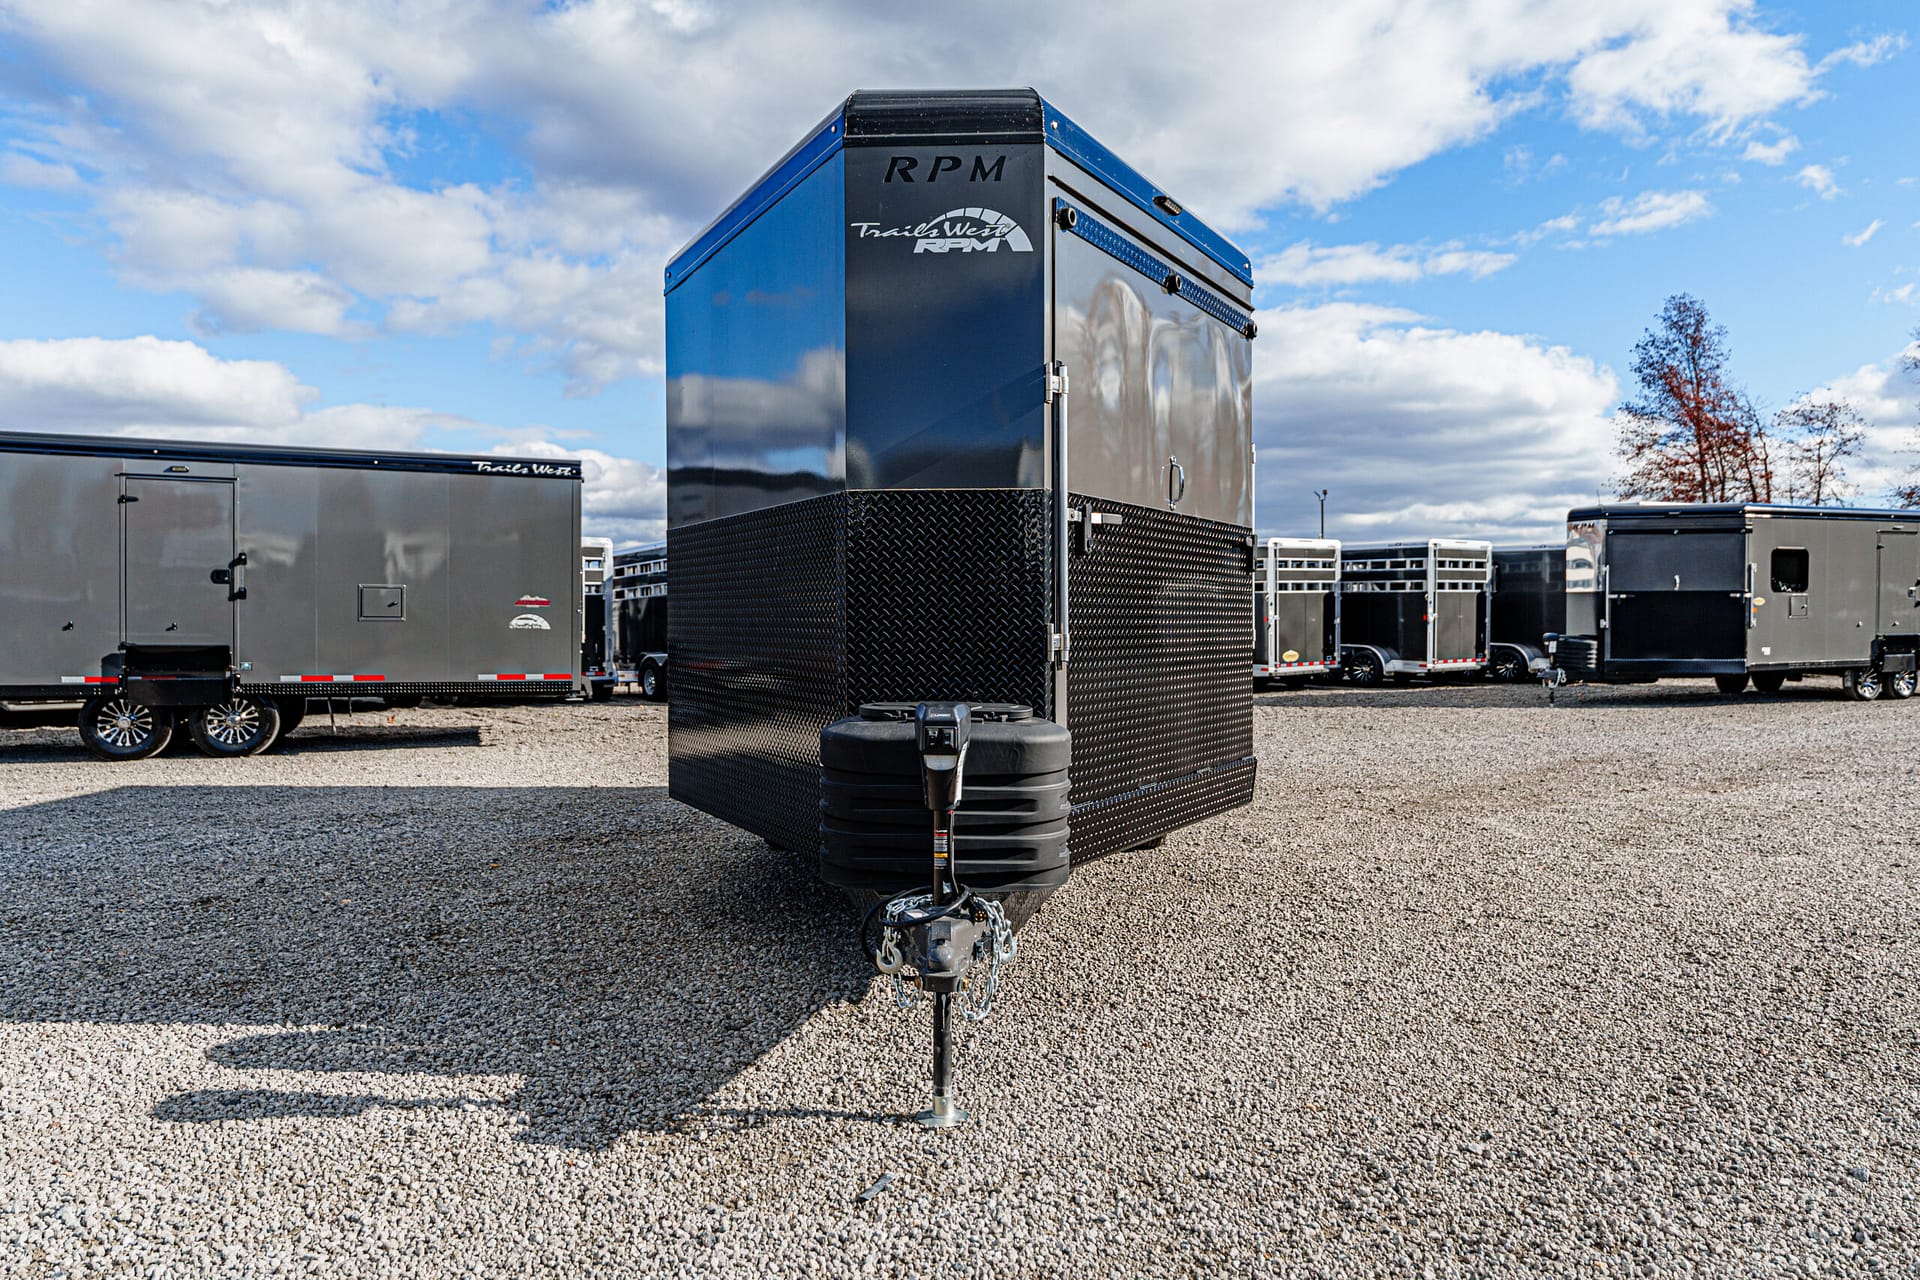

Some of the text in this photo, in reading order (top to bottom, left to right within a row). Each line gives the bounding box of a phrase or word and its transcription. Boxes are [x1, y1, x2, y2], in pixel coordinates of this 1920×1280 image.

[884, 155, 1006, 183] RPM
[850, 221, 940, 238] Trails
[913, 238, 1001, 254] RPM
[471, 461, 529, 474] Trails
